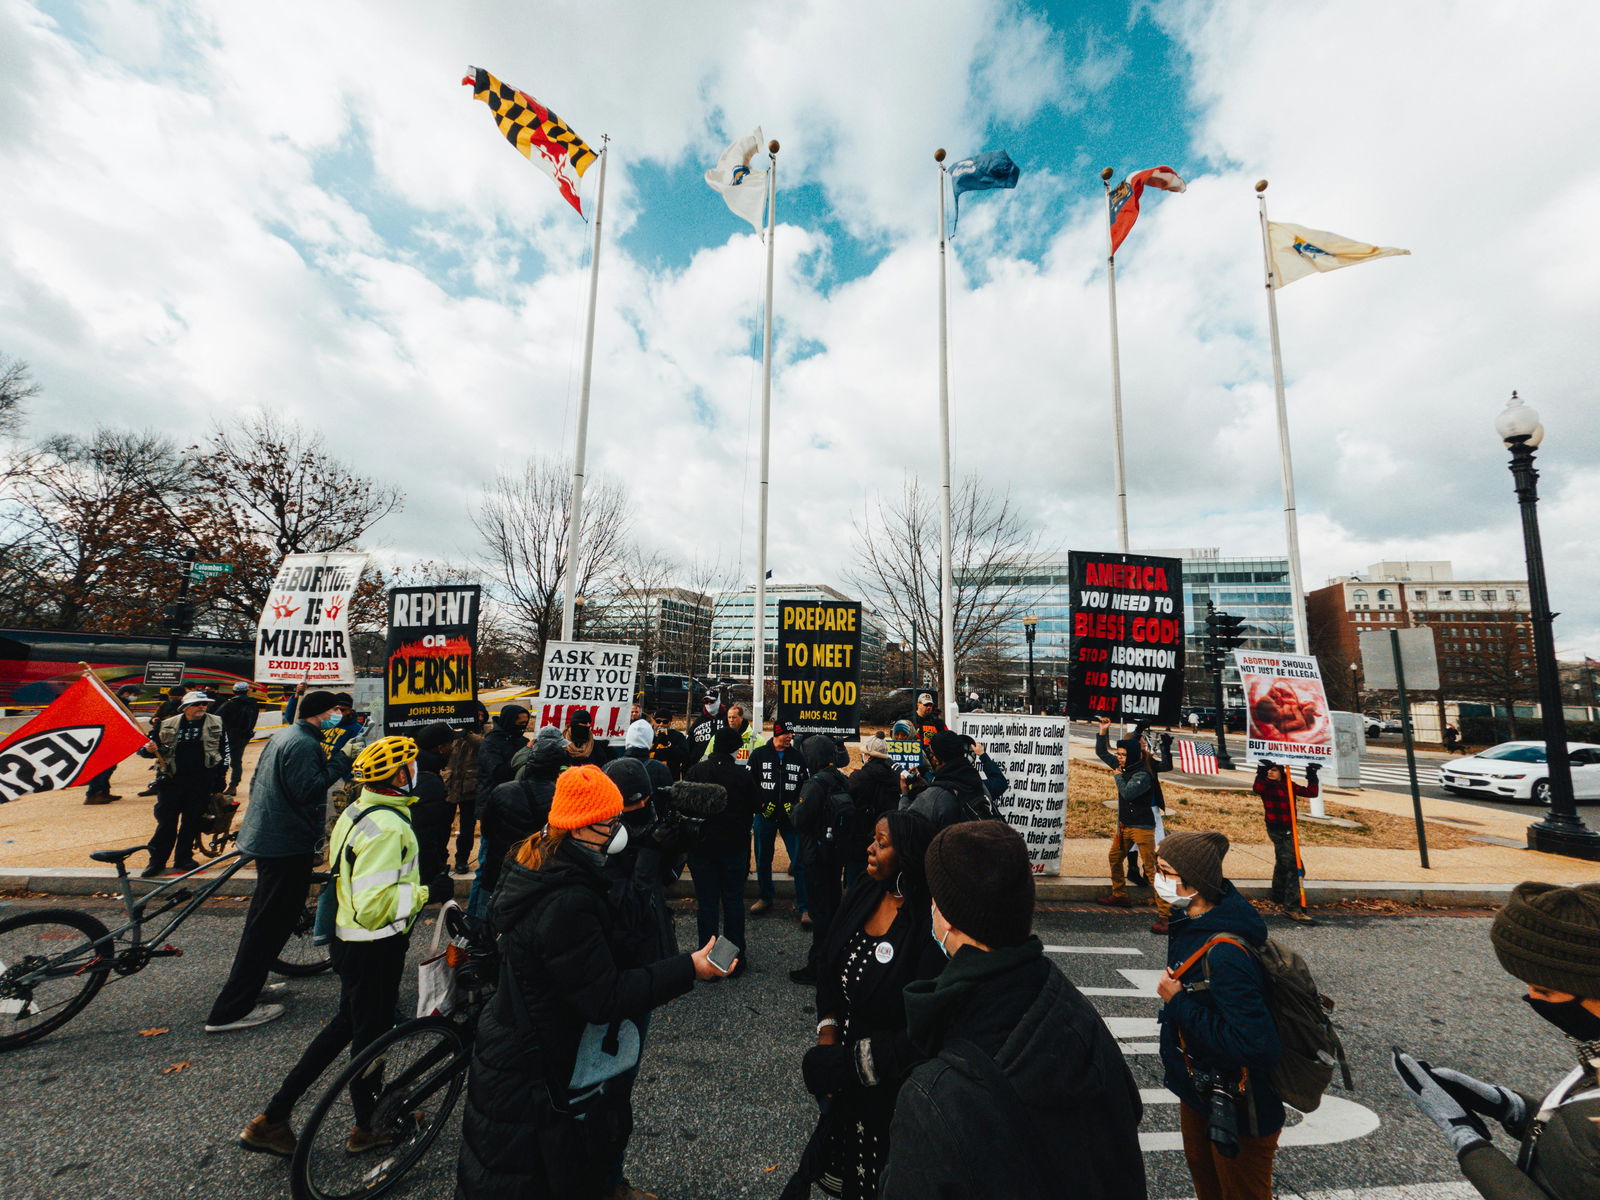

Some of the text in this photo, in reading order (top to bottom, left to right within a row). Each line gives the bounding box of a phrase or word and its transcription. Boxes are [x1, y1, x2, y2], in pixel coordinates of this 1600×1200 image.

[194, 562, 223, 572] Columbus
[275, 566, 354, 592] ABORTION
[1085, 562, 1168, 592] AMERICA
[304, 598, 323, 625] IS
[393, 591, 475, 627] REPENT
[1080, 591, 1173, 614] YOU NEED TO
[783, 606, 856, 631] PREPARE
[1074, 612, 1180, 646] BLESS GOD!
[259, 629, 347, 658] MURDER
[423, 634, 447, 648] OR
[549, 649, 633, 668] ASK ME
[785, 643, 853, 668] TO MEET
[1078, 646, 1176, 669] STOP ABORTION
[1243, 656, 1313, 670] ABORTION SHOULD
[268, 660, 339, 671] EXODUS 20:13
[1240, 664, 1319, 679] NOT JUST BE ILLEGAL
[391, 654, 470, 698] PERISH
[548, 666, 632, 685] WHY YOU
[1084, 669, 1166, 692] END SODOMY
[545, 684, 629, 702] DESERVE
[781, 680, 857, 705] THY GOD
[408, 705, 455, 716] JOHN 3:16-36
[1088, 694, 1160, 716] HALT ISLAM
[799, 710, 837, 720] AMOS 4:12
[694, 733, 711, 743] GOD
[962, 721, 1065, 739] If my people, which are called
[887, 741, 921, 754] ESUS
[989, 742, 1011, 756] name,
[1013, 740, 1033, 754] shall
[1035, 741, 1063, 756] humble
[1248, 740, 1332, 756] BUT UNTHINKABLE
[762, 762, 772, 770] BE
[903, 754, 920, 762] YOU
[762, 772, 772, 780] YE
[1010, 759, 1026, 772] and
[1027, 763, 1048, 777] pray,
[1050, 761, 1065, 775] and
[788, 773, 798, 782] THE
[1013, 777, 1028, 791] and
[1030, 781, 1047, 792] turn
[1048, 779, 1064, 794] from
[996, 794, 1064, 813] cked ways; then
[1008, 811, 1029, 826] from
[1027, 831, 1047, 844] their
[1028, 848, 1040, 860] eir
